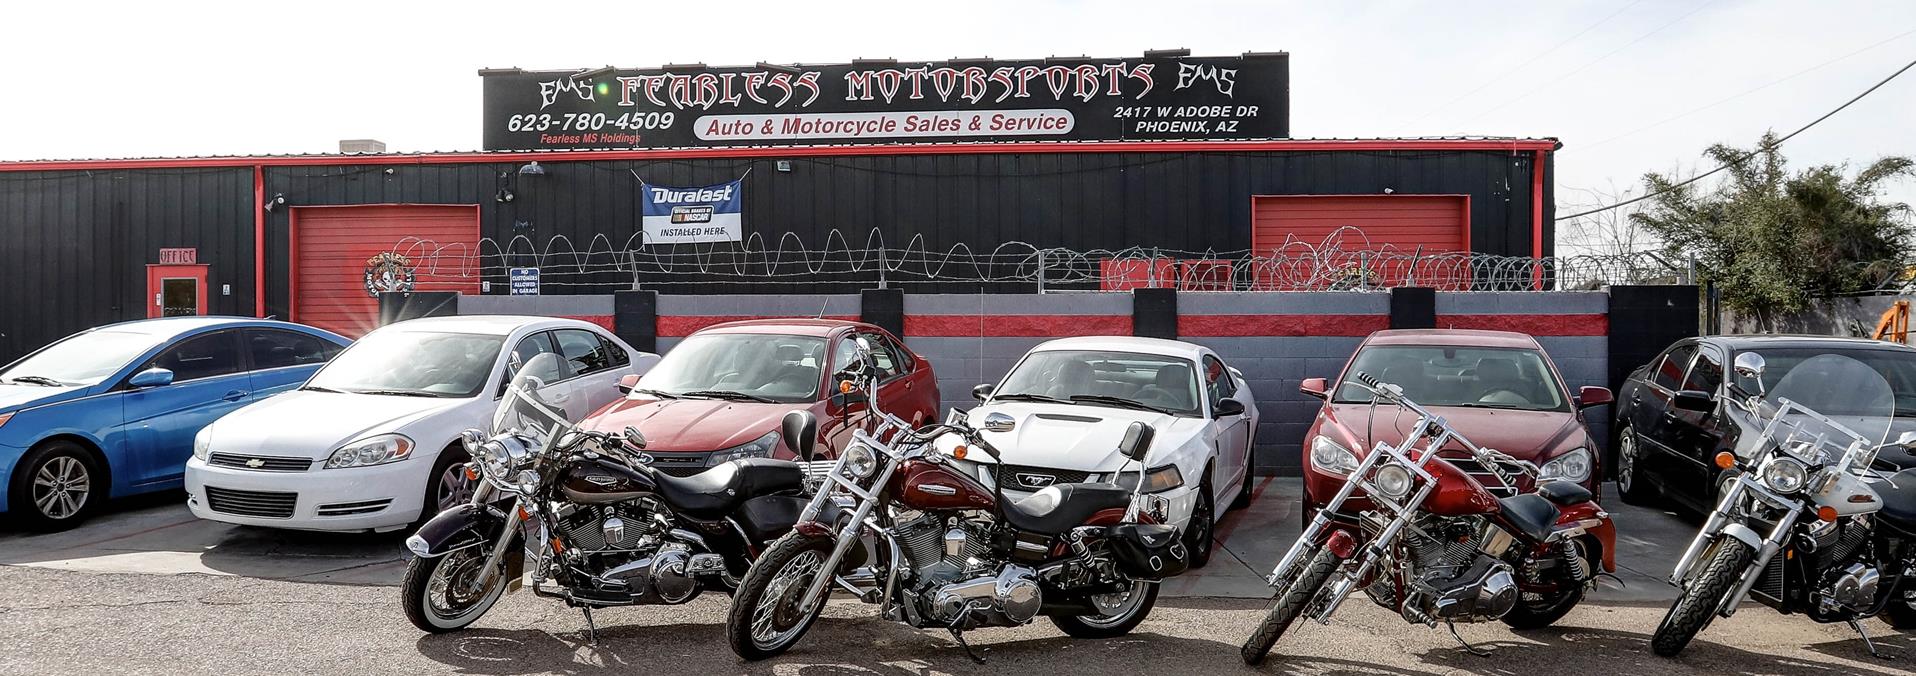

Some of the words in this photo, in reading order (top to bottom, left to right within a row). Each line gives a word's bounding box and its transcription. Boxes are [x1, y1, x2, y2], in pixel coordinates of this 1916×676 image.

[616, 72, 821, 111] FEARLESS
[844, 61, 1155, 104] MOTORSPORTS
[1113, 106, 1152, 118] 2417
[1157, 106, 1173, 118] W
[1174, 105, 1231, 118] ADOBE
[1236, 105, 1259, 117] DR
[508, 111, 675, 132] 623-780-4509
[706, 119, 754, 136] Auto
[761, 118, 774, 135] &
[781, 115, 897, 136] Motorcycle
[903, 115, 962, 133] Sales
[968, 114, 981, 131] &
[989, 113, 1068, 131] Service
[1135, 121, 1211, 135] PHOENIX,
[1215, 120, 1239, 132] AZ
[540, 133, 580, 144] Fearless
[582, 133, 598, 143] MS
[600, 132, 641, 144] Holdings
[651, 185, 732, 204] Duralast
[684, 213, 710, 222] NASCAR
[660, 228, 701, 237] INSTALLED
[704, 227, 725, 236] HERE
[161, 251, 193, 262] OFFICE
